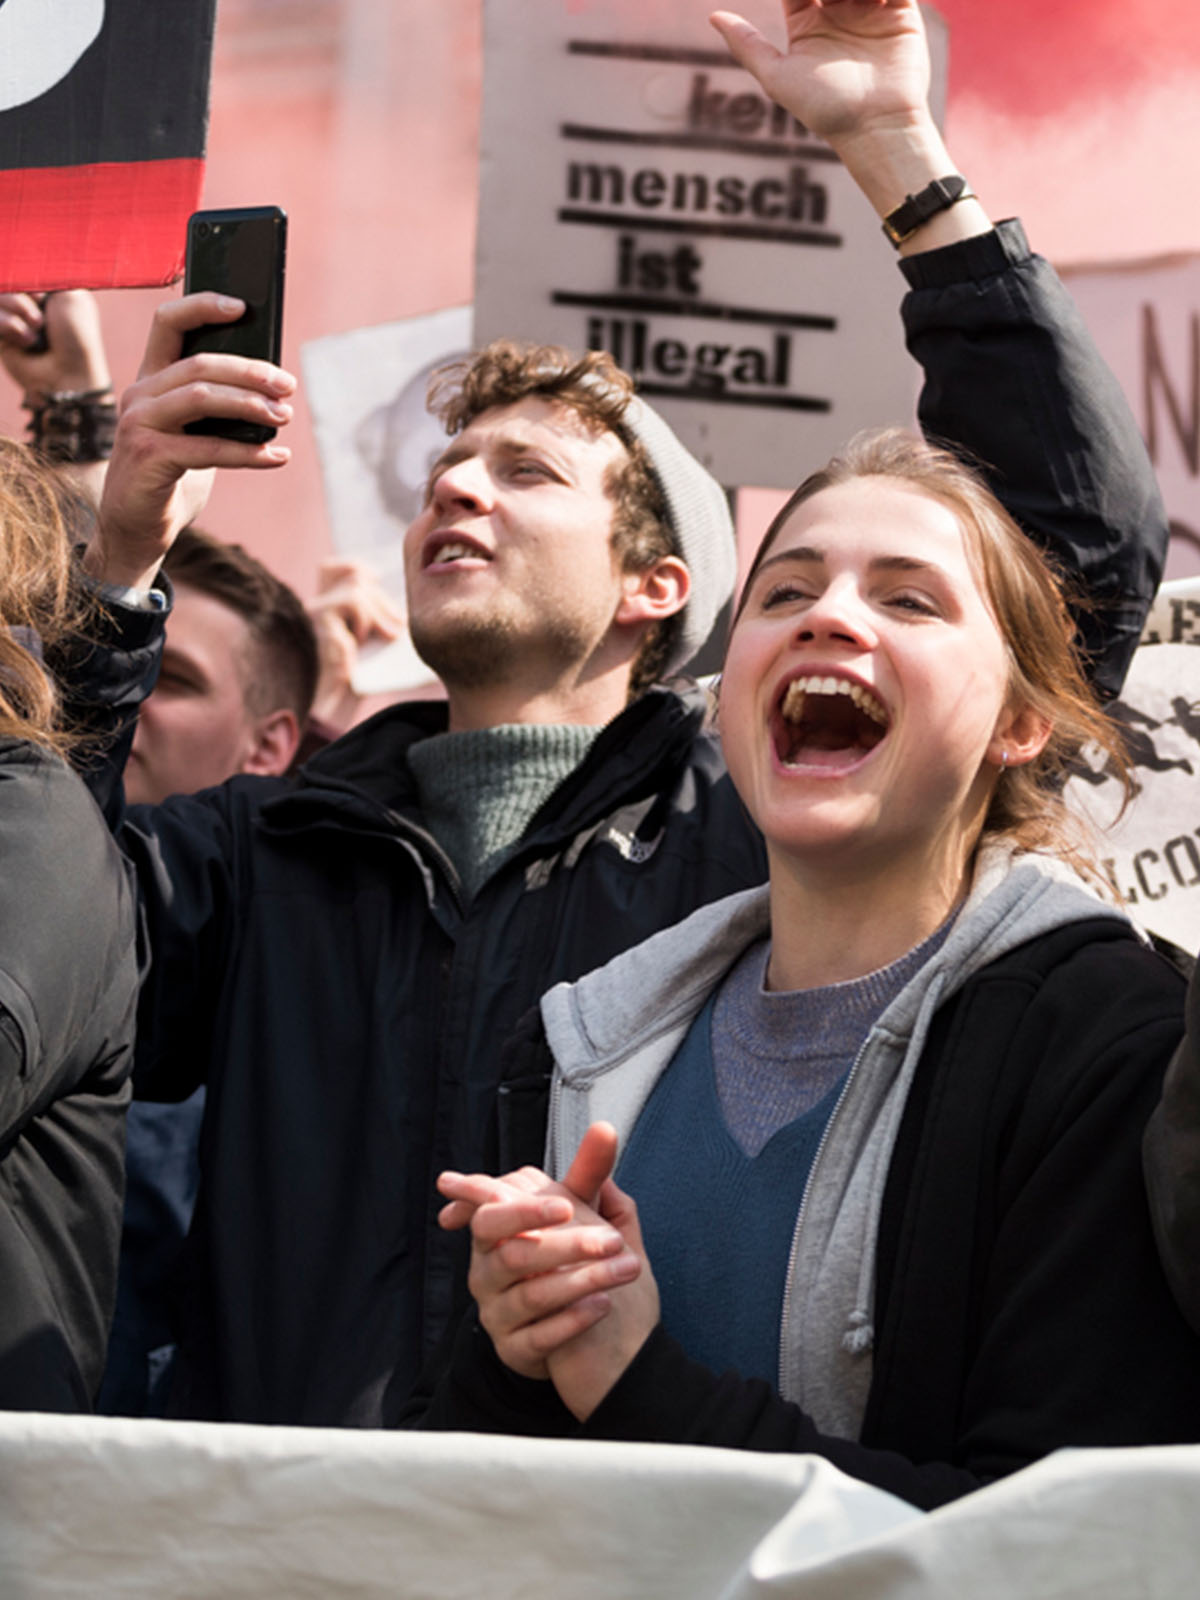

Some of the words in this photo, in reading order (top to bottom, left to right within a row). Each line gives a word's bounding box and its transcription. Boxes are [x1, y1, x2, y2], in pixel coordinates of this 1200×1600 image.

[687, 72, 811, 137] kei
[568, 161, 829, 225] mensch
[618, 234, 703, 293] ist
[587, 318, 791, 396] illegal
